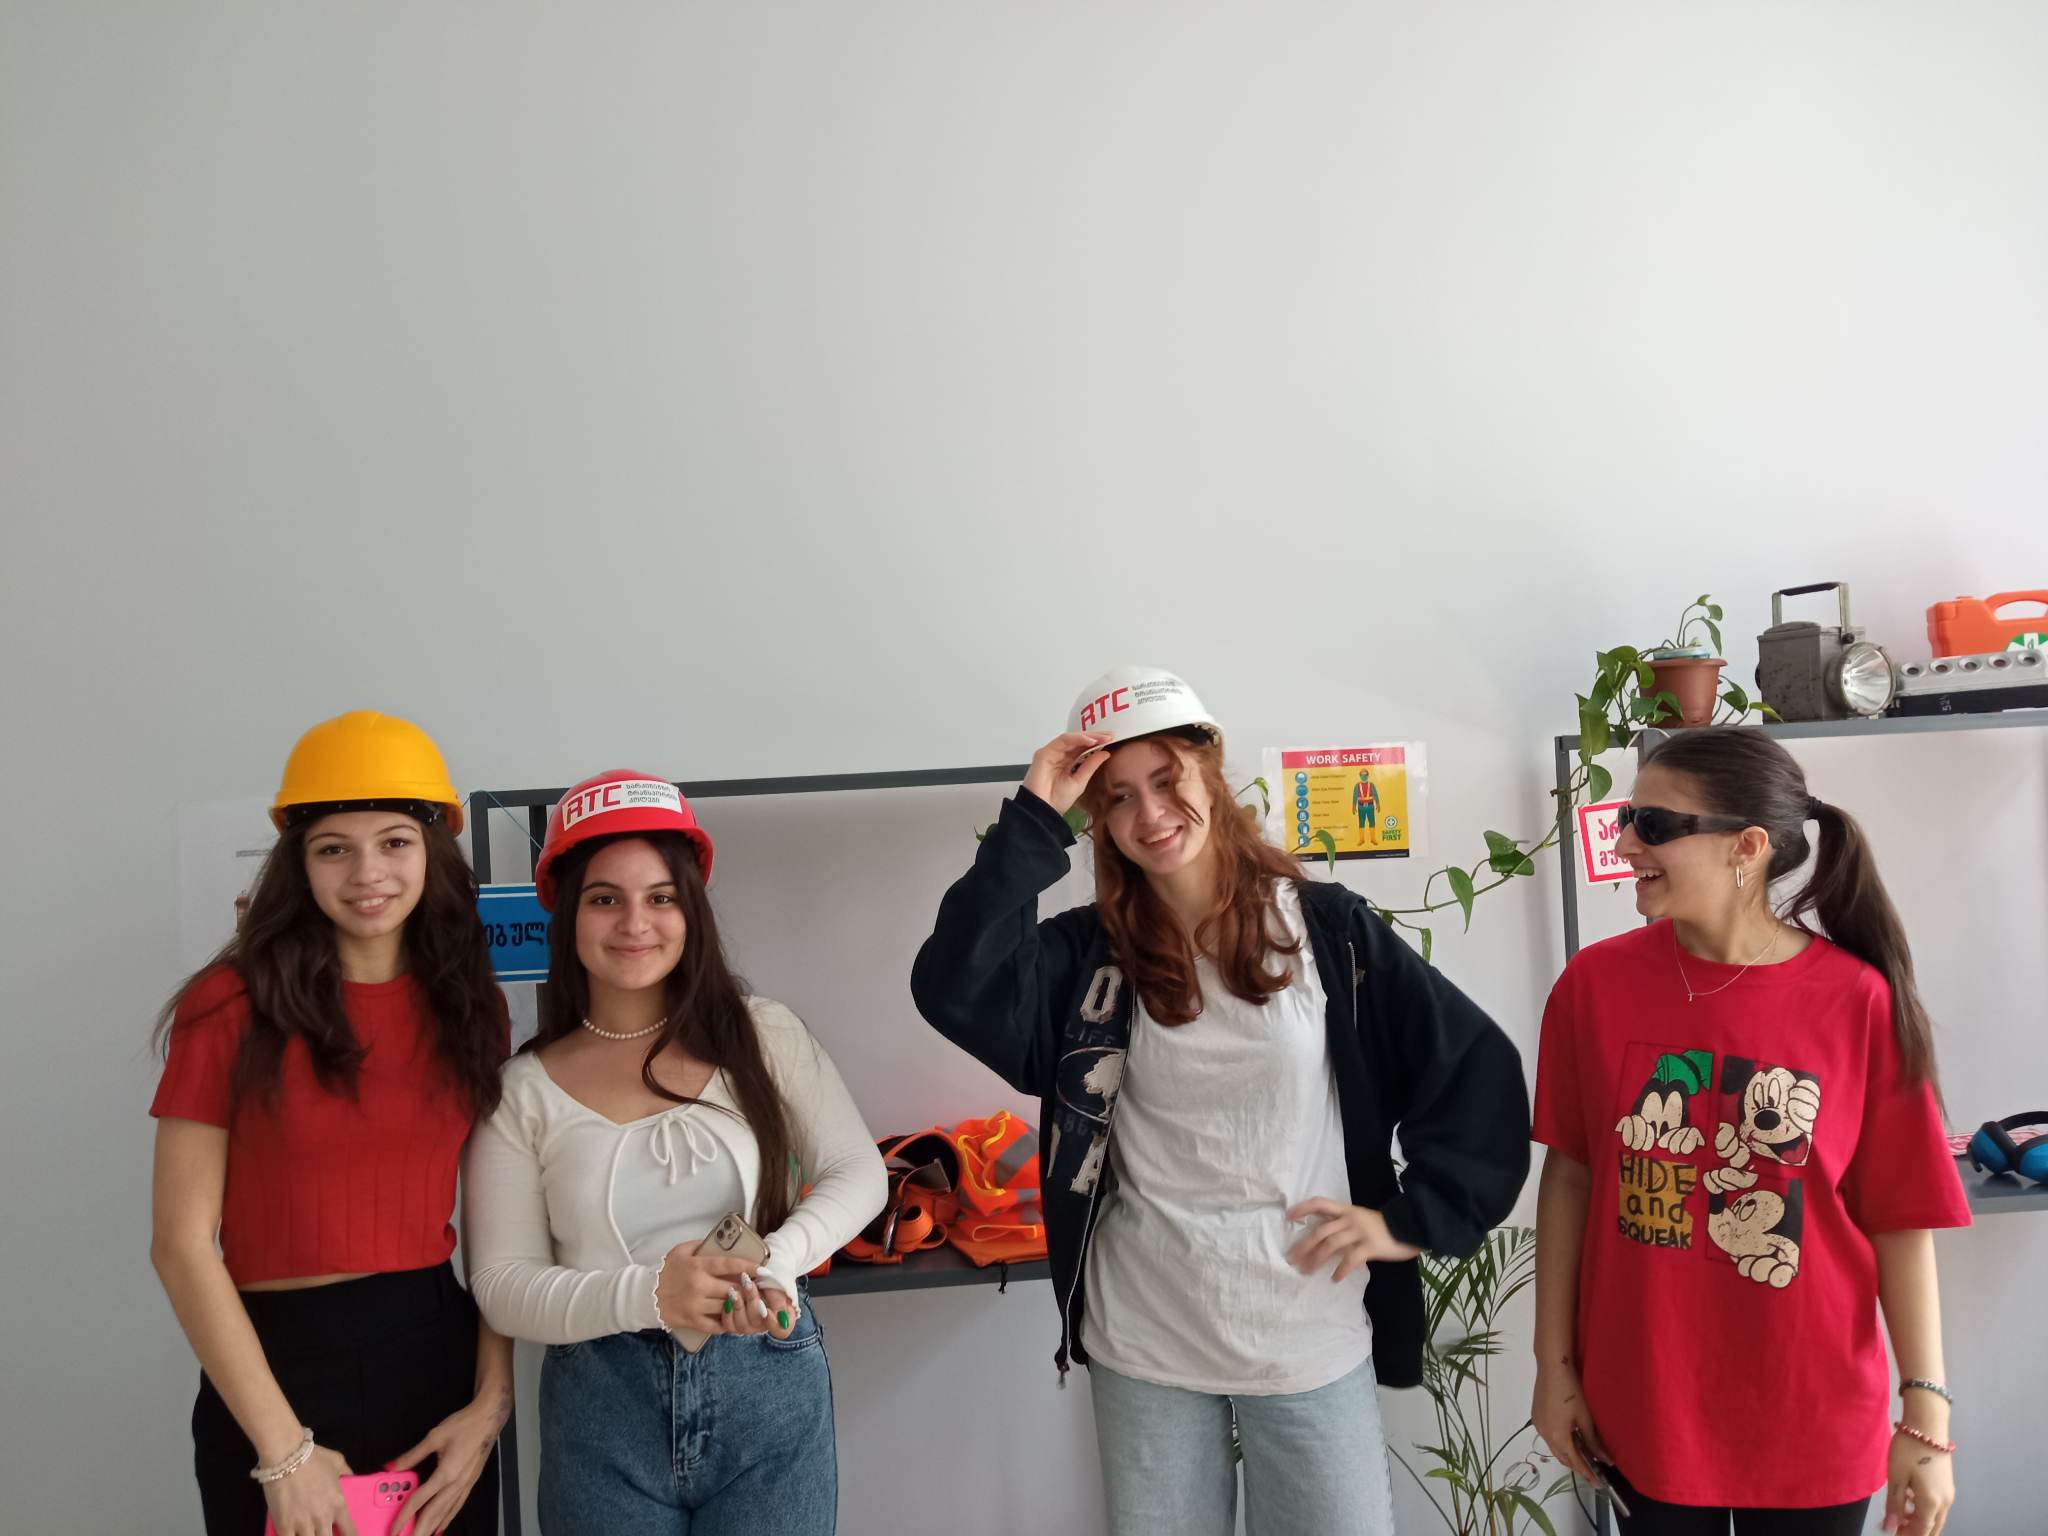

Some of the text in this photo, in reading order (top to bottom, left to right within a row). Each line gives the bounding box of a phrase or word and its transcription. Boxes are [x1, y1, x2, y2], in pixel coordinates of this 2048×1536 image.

[1306, 753, 1381, 765] WORK SAFETY
[1619, 1152, 1697, 1195] HIDE
[1627, 1194, 1686, 1224] and
[1617, 1216, 1692, 1249] SQUEAK
